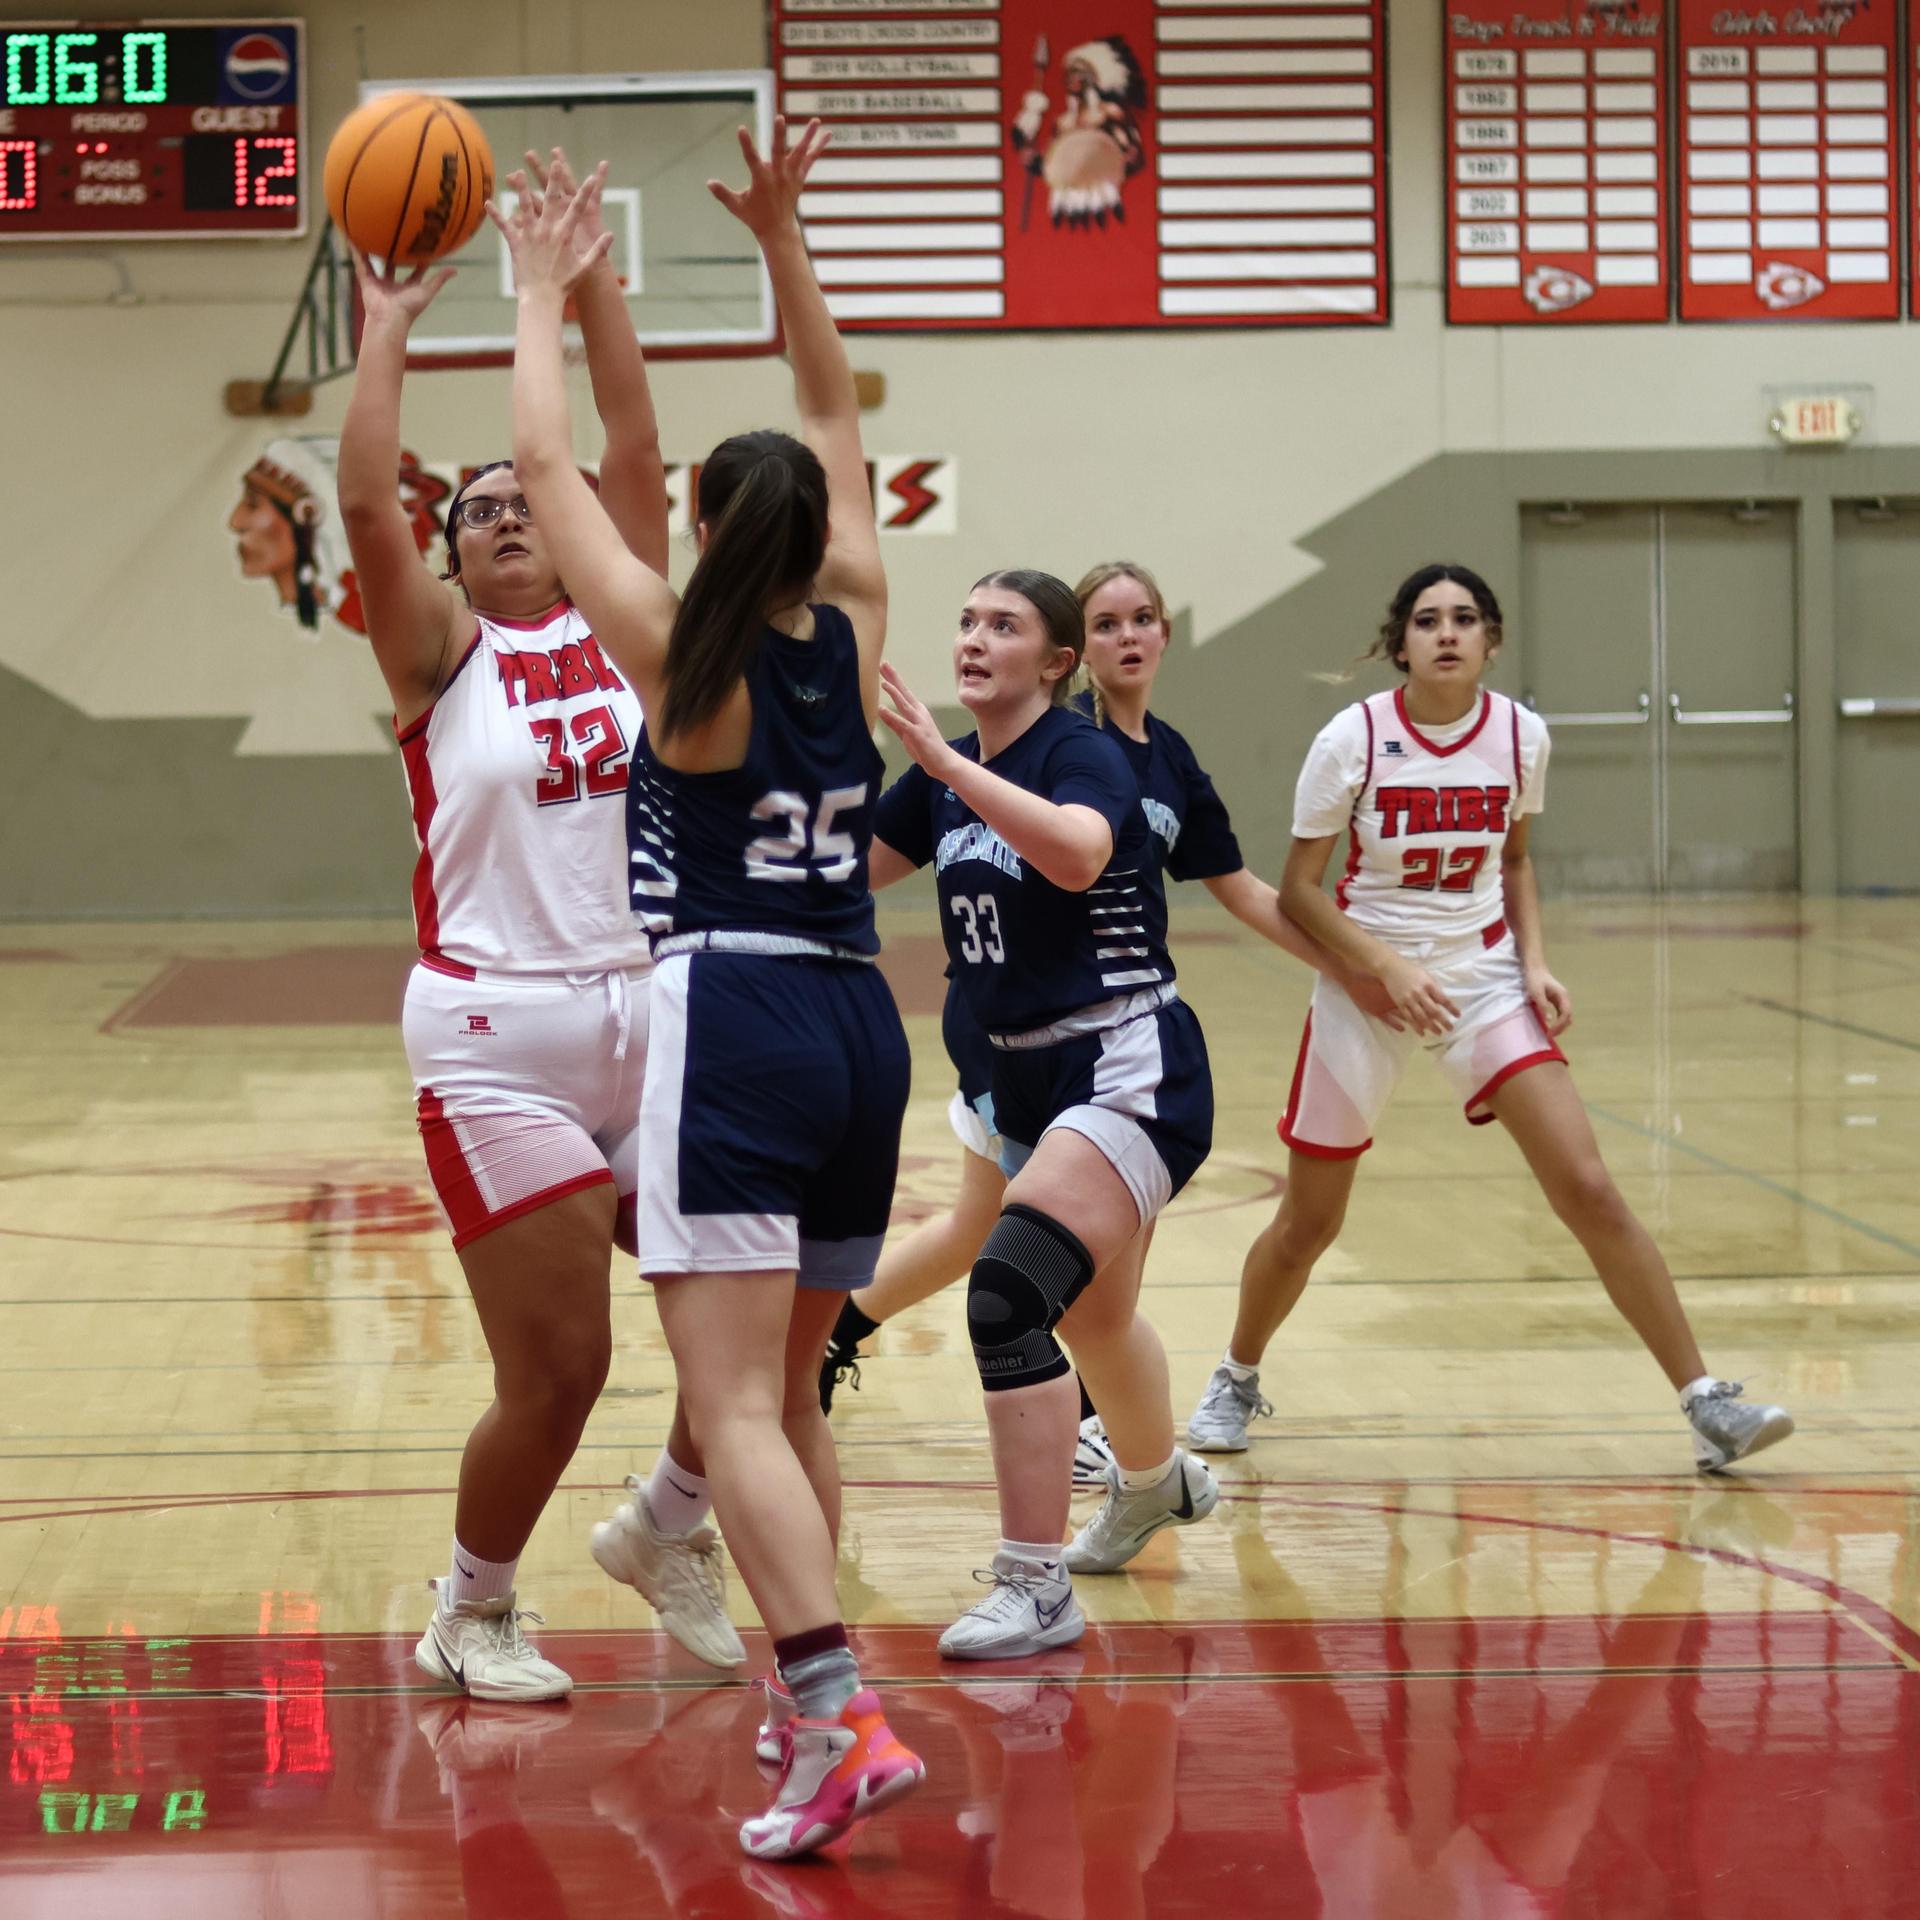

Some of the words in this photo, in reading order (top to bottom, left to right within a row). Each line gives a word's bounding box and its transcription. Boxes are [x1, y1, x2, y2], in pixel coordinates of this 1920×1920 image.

[70, 112, 147, 132] PERIOD
[191, 106, 282, 131] GUEST
[74, 184, 147, 205] BONUS
[235, 137, 296, 206] 12
[528, 704, 630, 808] 32
[744, 782, 868, 883] 25
[1374, 785, 1510, 839] TRIBE
[1397, 845, 1490, 893] 22
[950, 893, 1005, 964] 33
